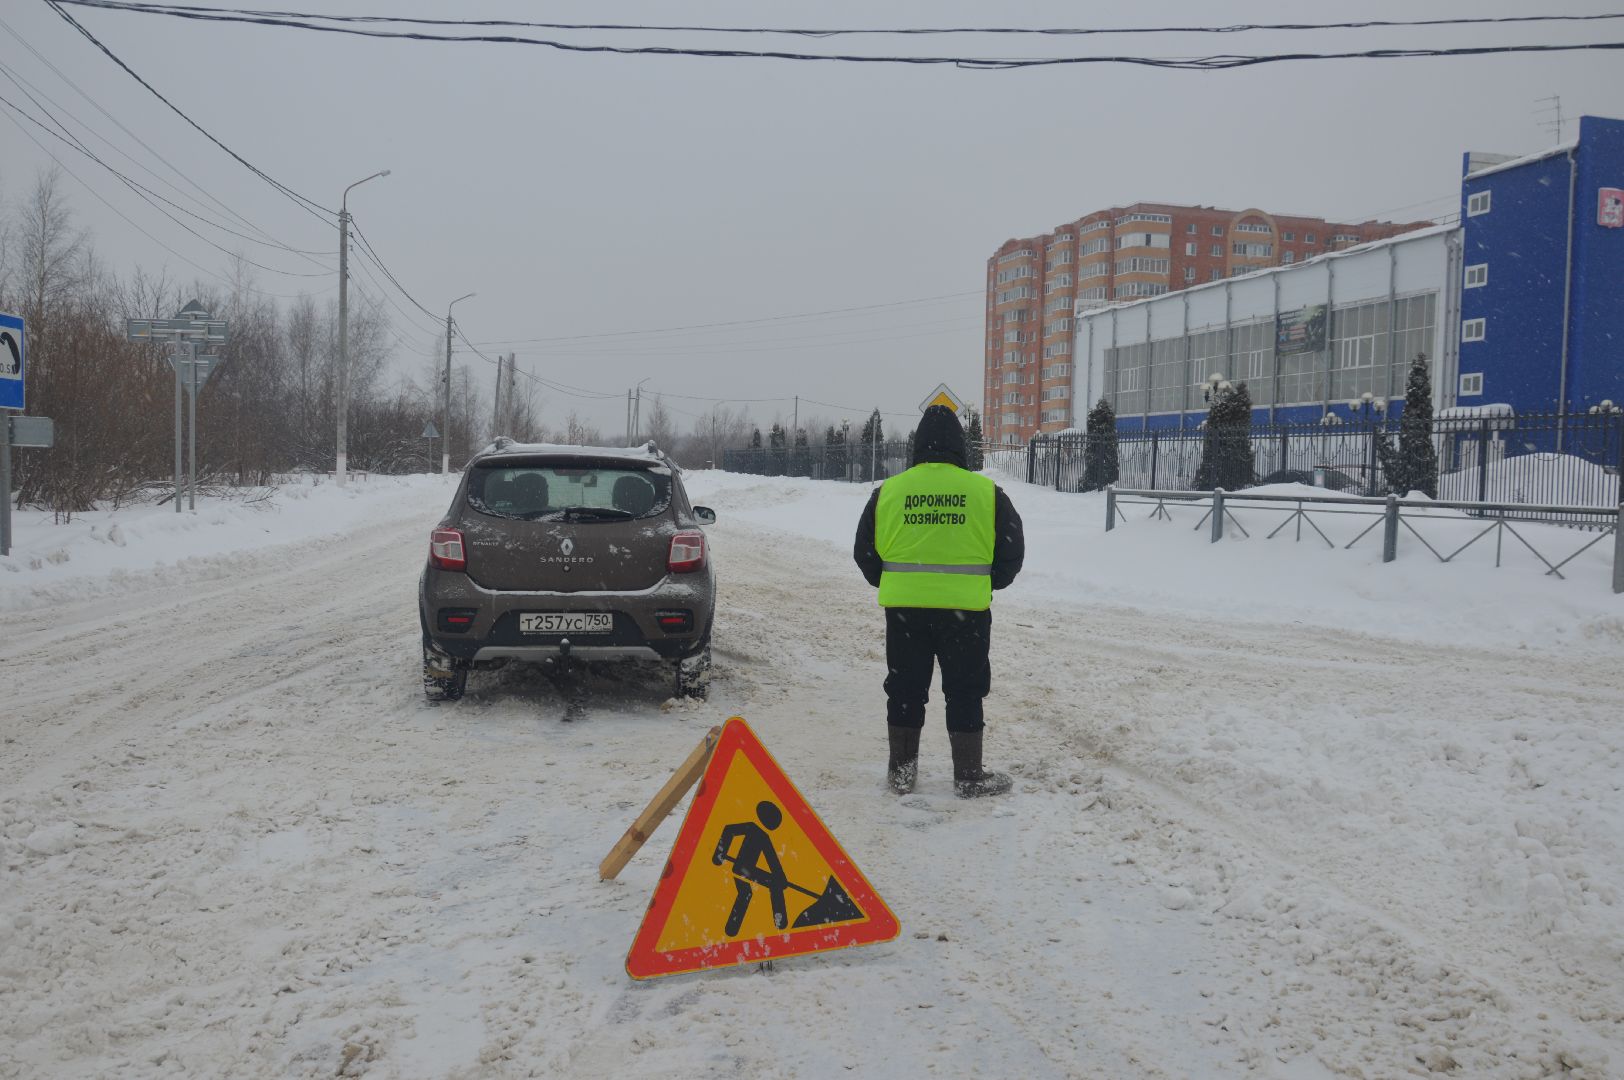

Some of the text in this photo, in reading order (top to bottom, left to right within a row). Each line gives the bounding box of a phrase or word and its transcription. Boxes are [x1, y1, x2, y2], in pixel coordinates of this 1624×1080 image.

[905, 495, 966, 510] ДОРОЖНОЕ
[904, 509, 966, 525] ХОЗЯЙСТВО
[586, 614, 609, 626] 750
